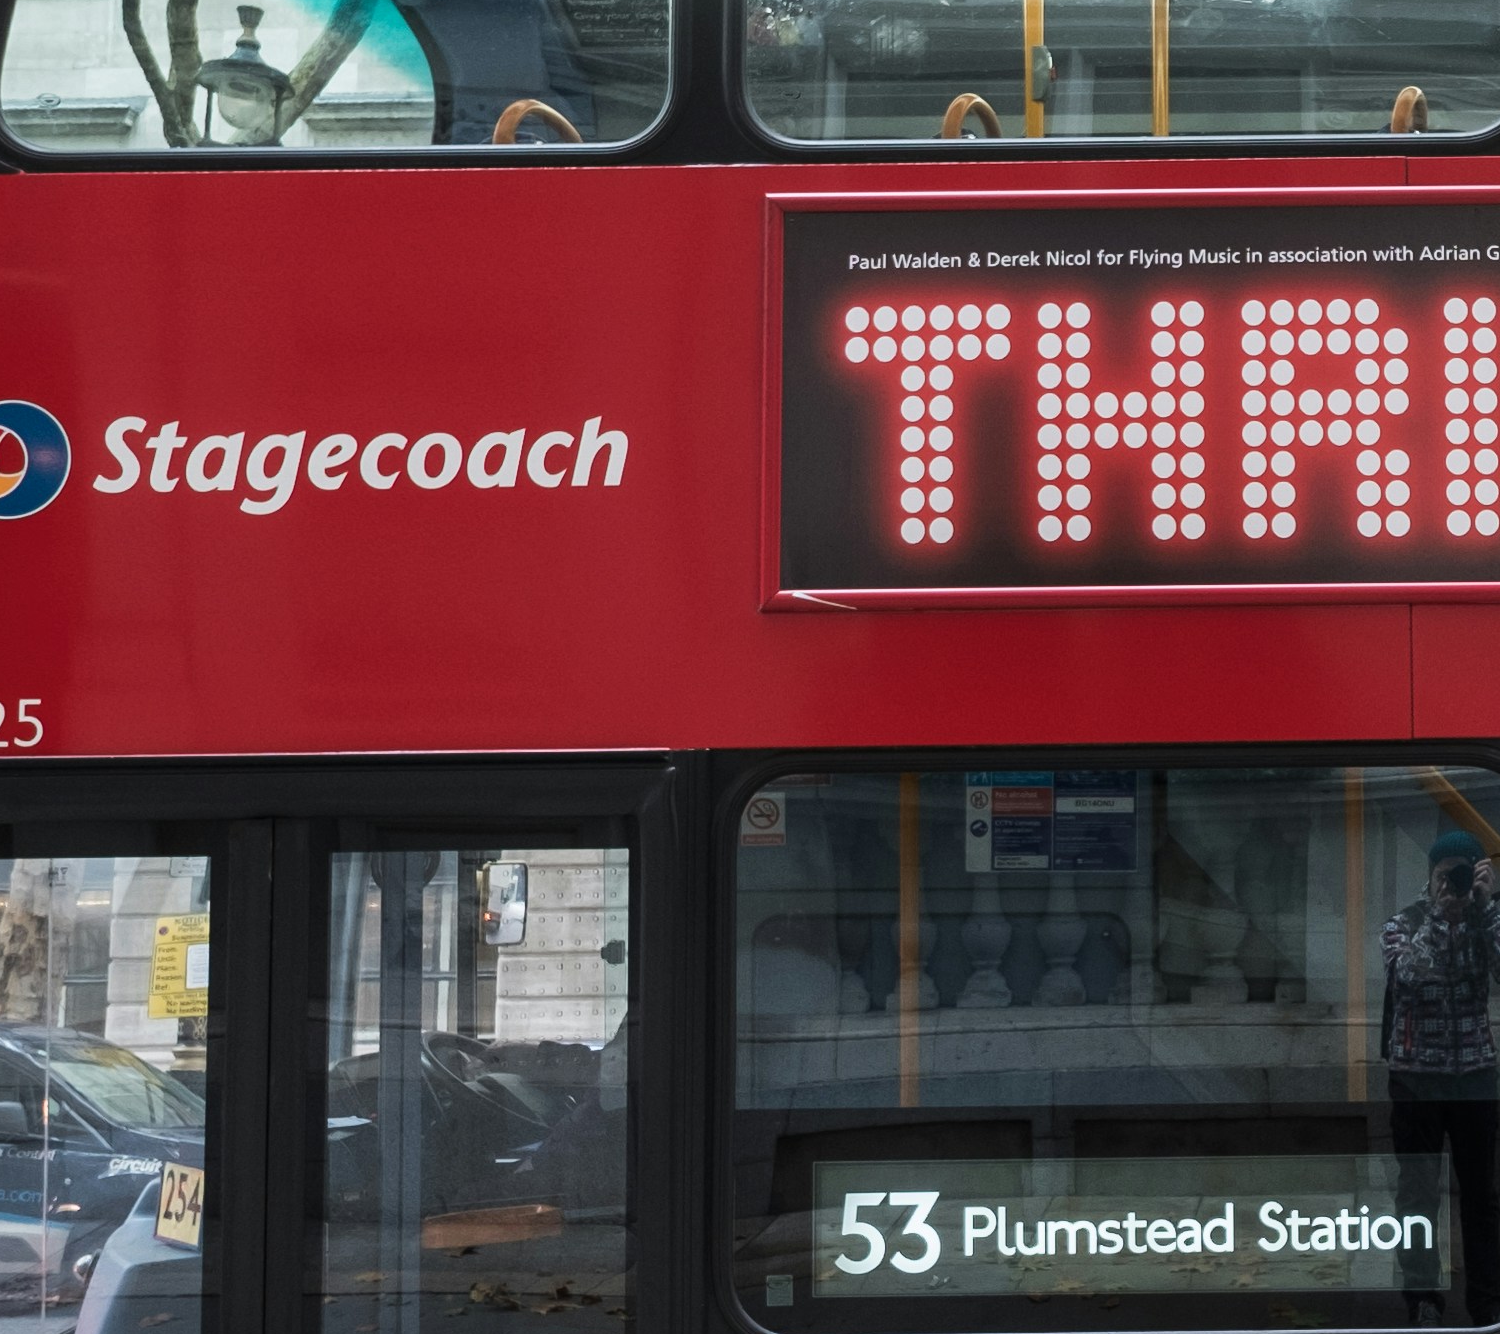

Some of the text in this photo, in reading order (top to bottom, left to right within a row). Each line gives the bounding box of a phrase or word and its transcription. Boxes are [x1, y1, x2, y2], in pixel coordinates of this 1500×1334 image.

[847, 252, 887, 270] Paul
[891, 251, 962, 269] Walden
[967, 251, 982, 268] &
[986, 250, 1041, 268] Derek
[1046, 249, 1091, 267] Nicol
[1096, 248, 1124, 266] for
[1129, 247, 1183, 269] Flying
[1188, 247, 1241, 265] Music
[1245, 246, 1264, 264] in
[1268, 245, 1368, 264] association
[1372, 245, 1414, 263] with
[1419, 244, 1481, 263] Adrian
[92, 415, 629, 516] Stagecoach
[108, 1154, 163, 1175] circuit
[834, 1190, 1434, 1275] 53 Plumstead Station
